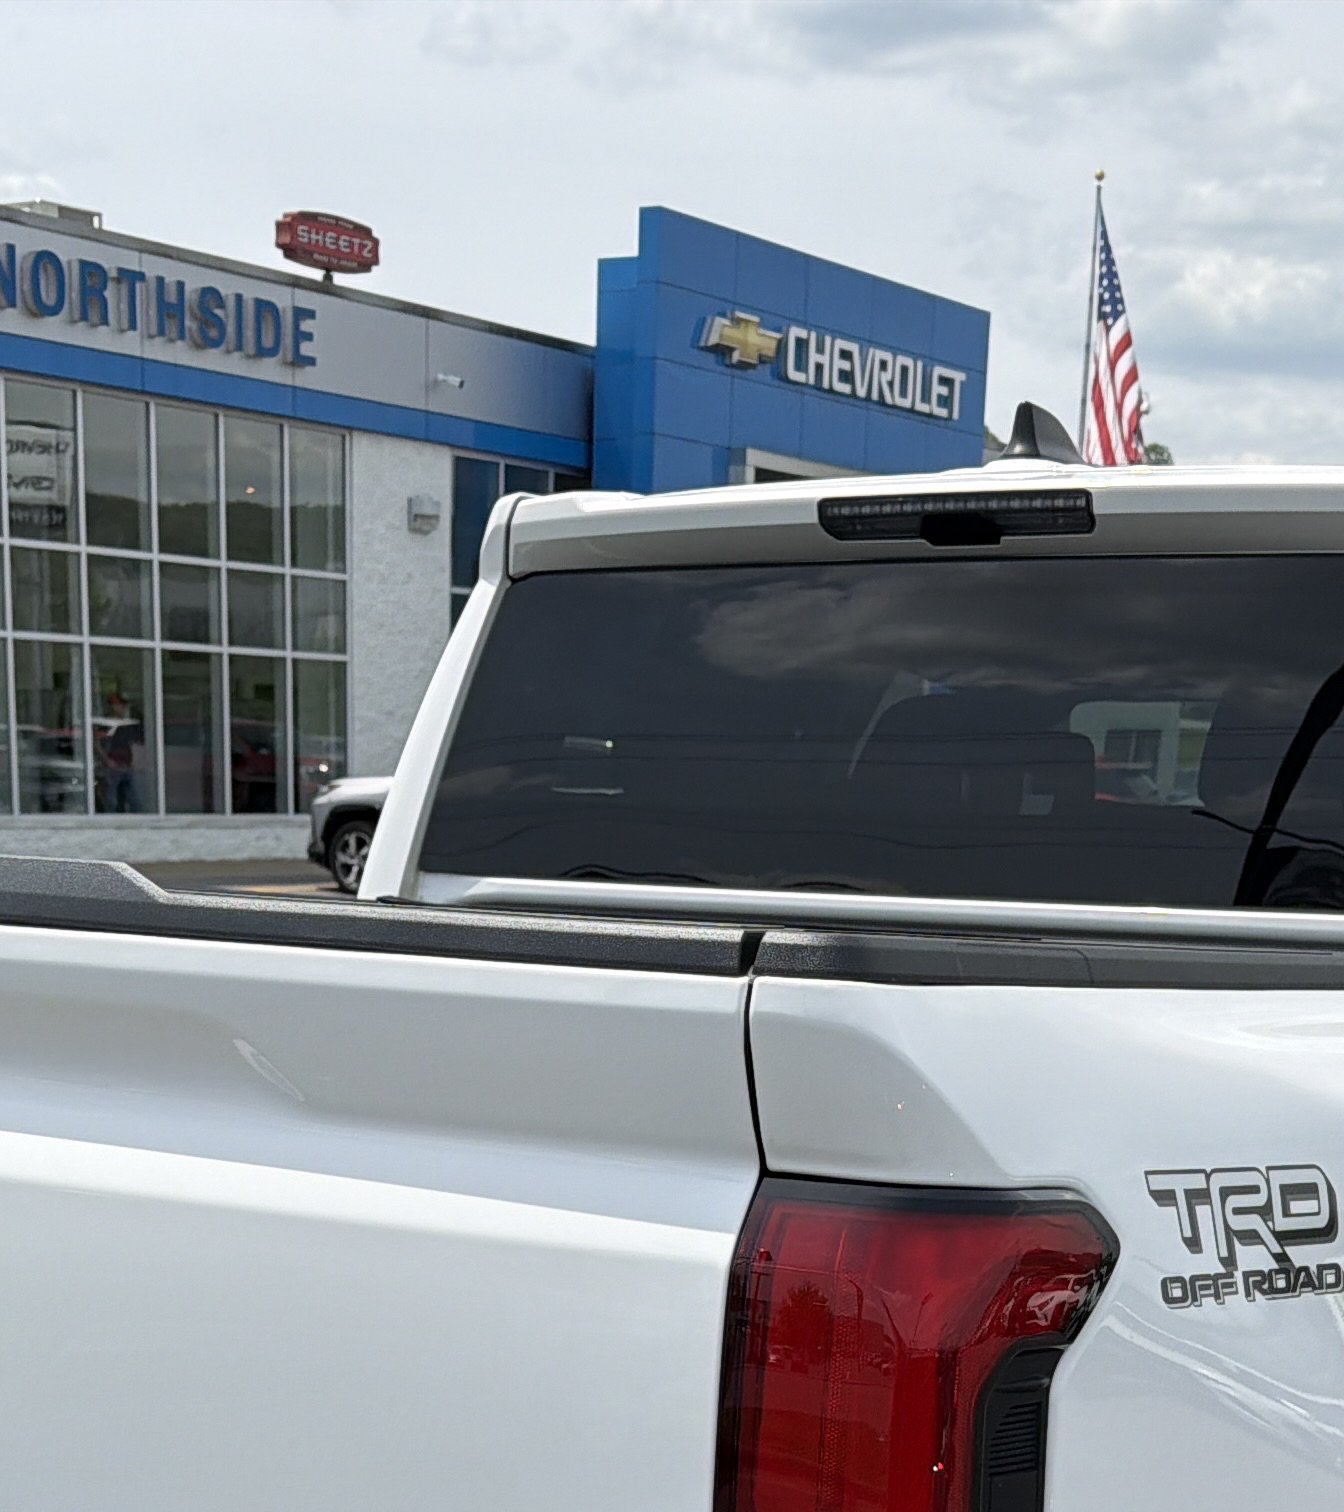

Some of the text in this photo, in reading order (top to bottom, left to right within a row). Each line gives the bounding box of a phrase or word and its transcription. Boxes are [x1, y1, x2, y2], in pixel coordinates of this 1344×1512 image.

[296, 224, 374, 258] SHEETZ
[785, 325, 967, 421] CHEVROLET
[1143, 1163, 1340, 1272] TRD
[1160, 1270, 1239, 1310] OFF
